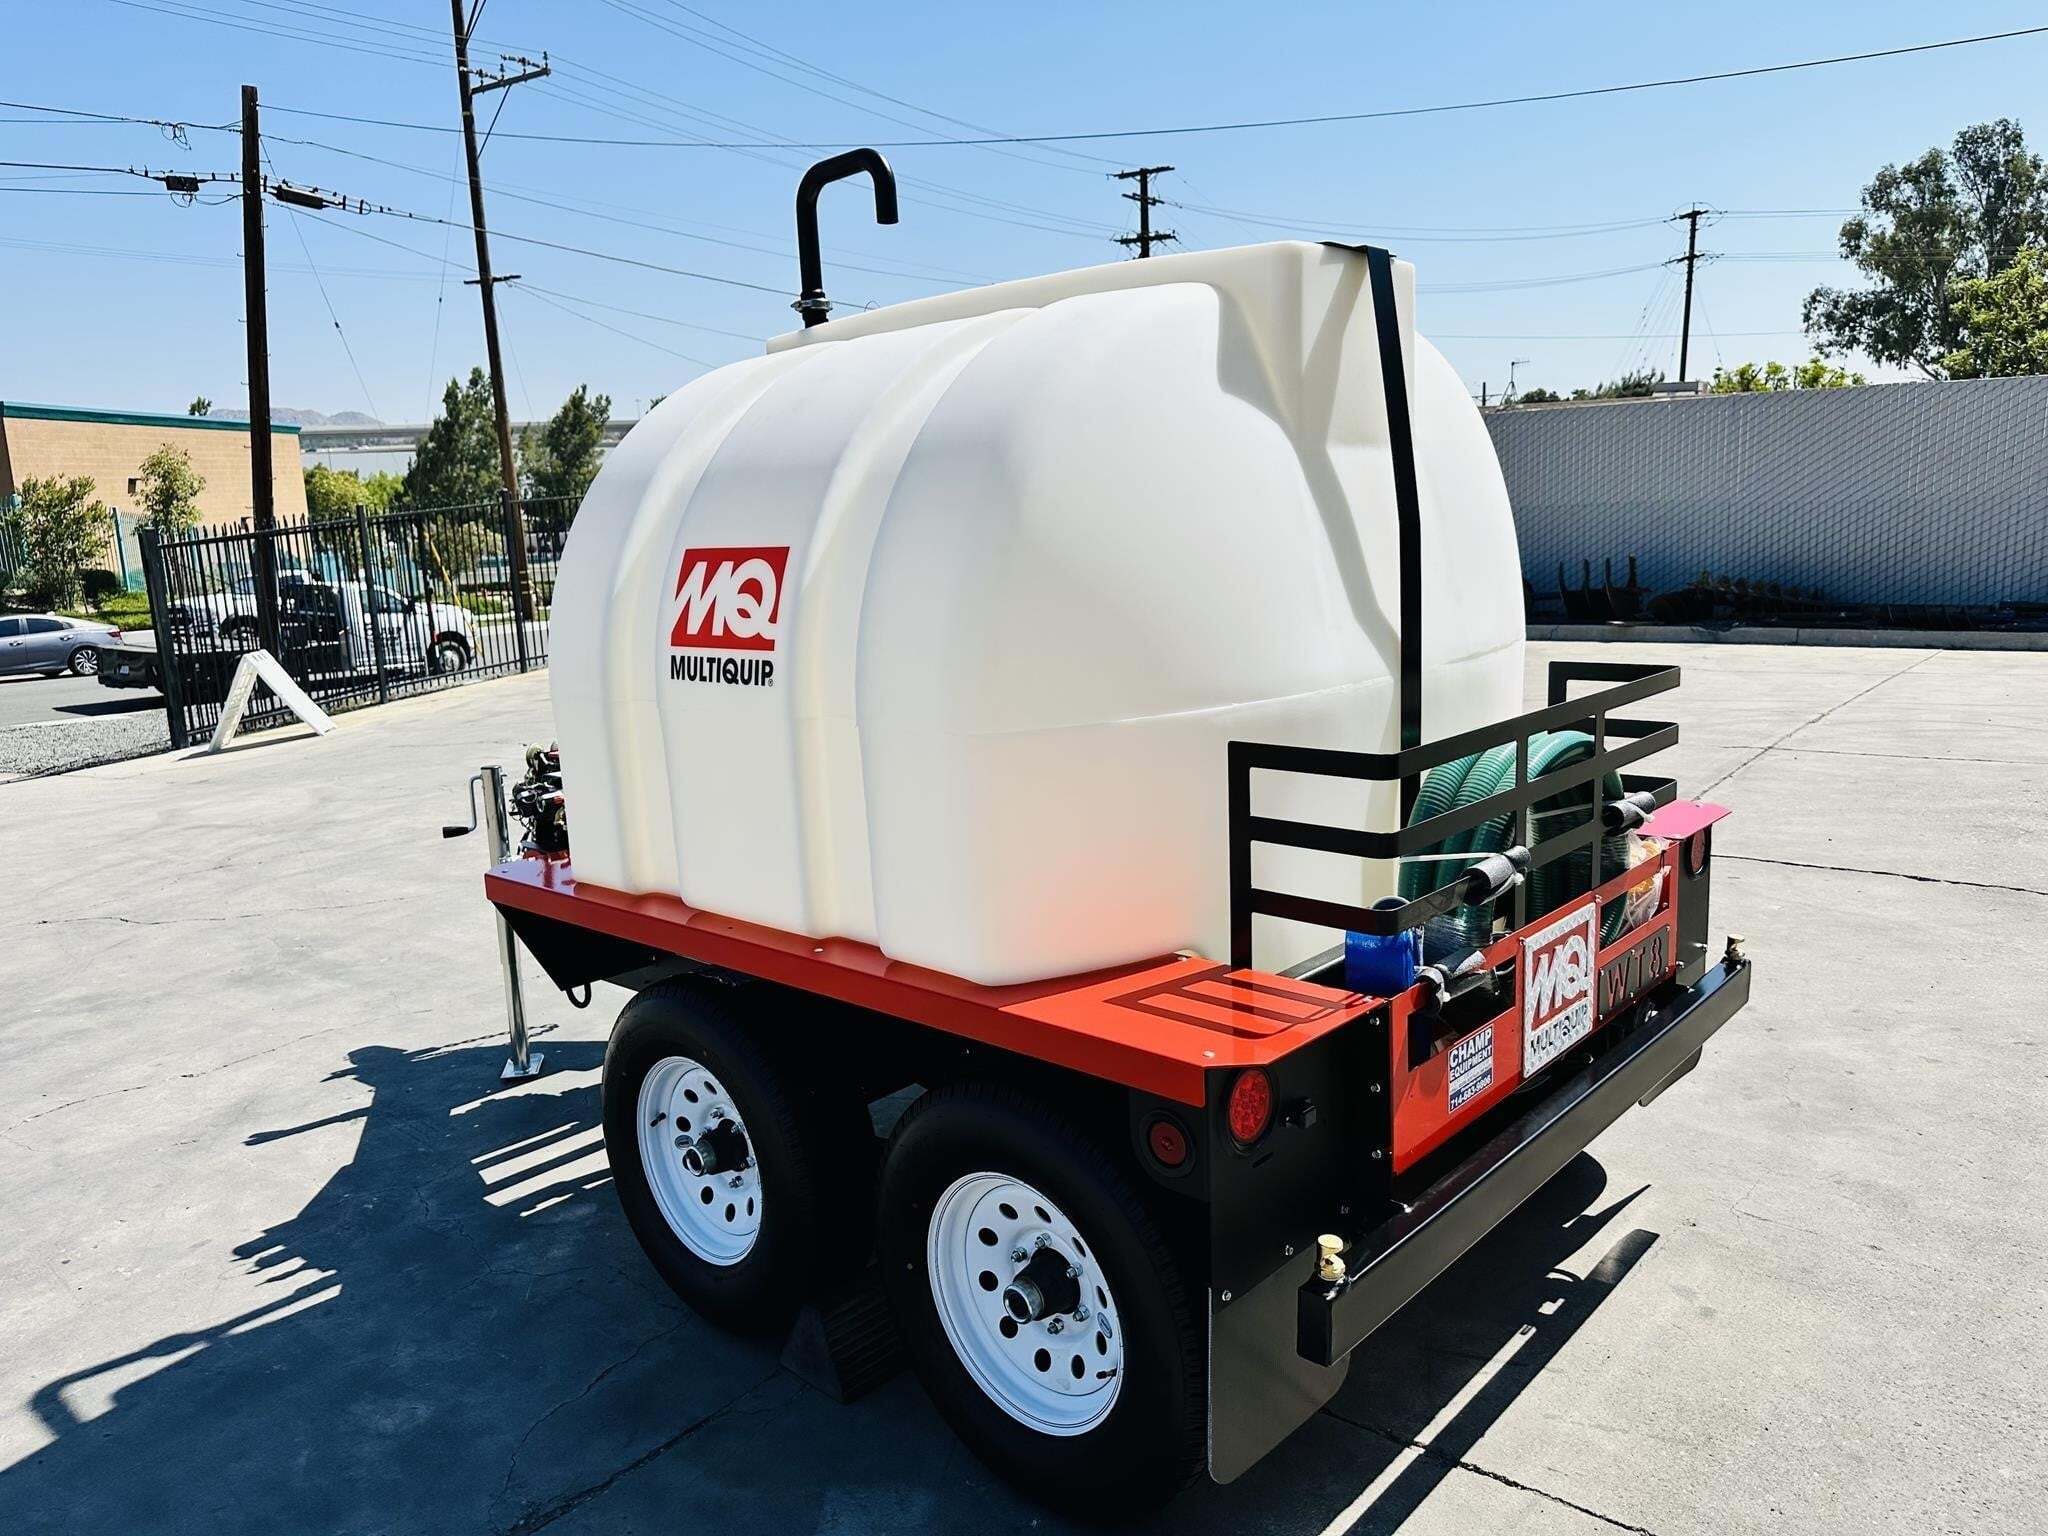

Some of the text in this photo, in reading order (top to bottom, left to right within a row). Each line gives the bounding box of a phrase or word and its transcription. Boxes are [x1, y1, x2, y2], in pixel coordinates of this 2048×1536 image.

[671, 558, 777, 640] MQ
[1532, 934, 1591, 1020] MQ
[1450, 1028, 1492, 1067] CHAMP
[1530, 1004, 1588, 1056] MULTIQUIP
[1450, 1046, 1492, 1081] EQUIPMENT
